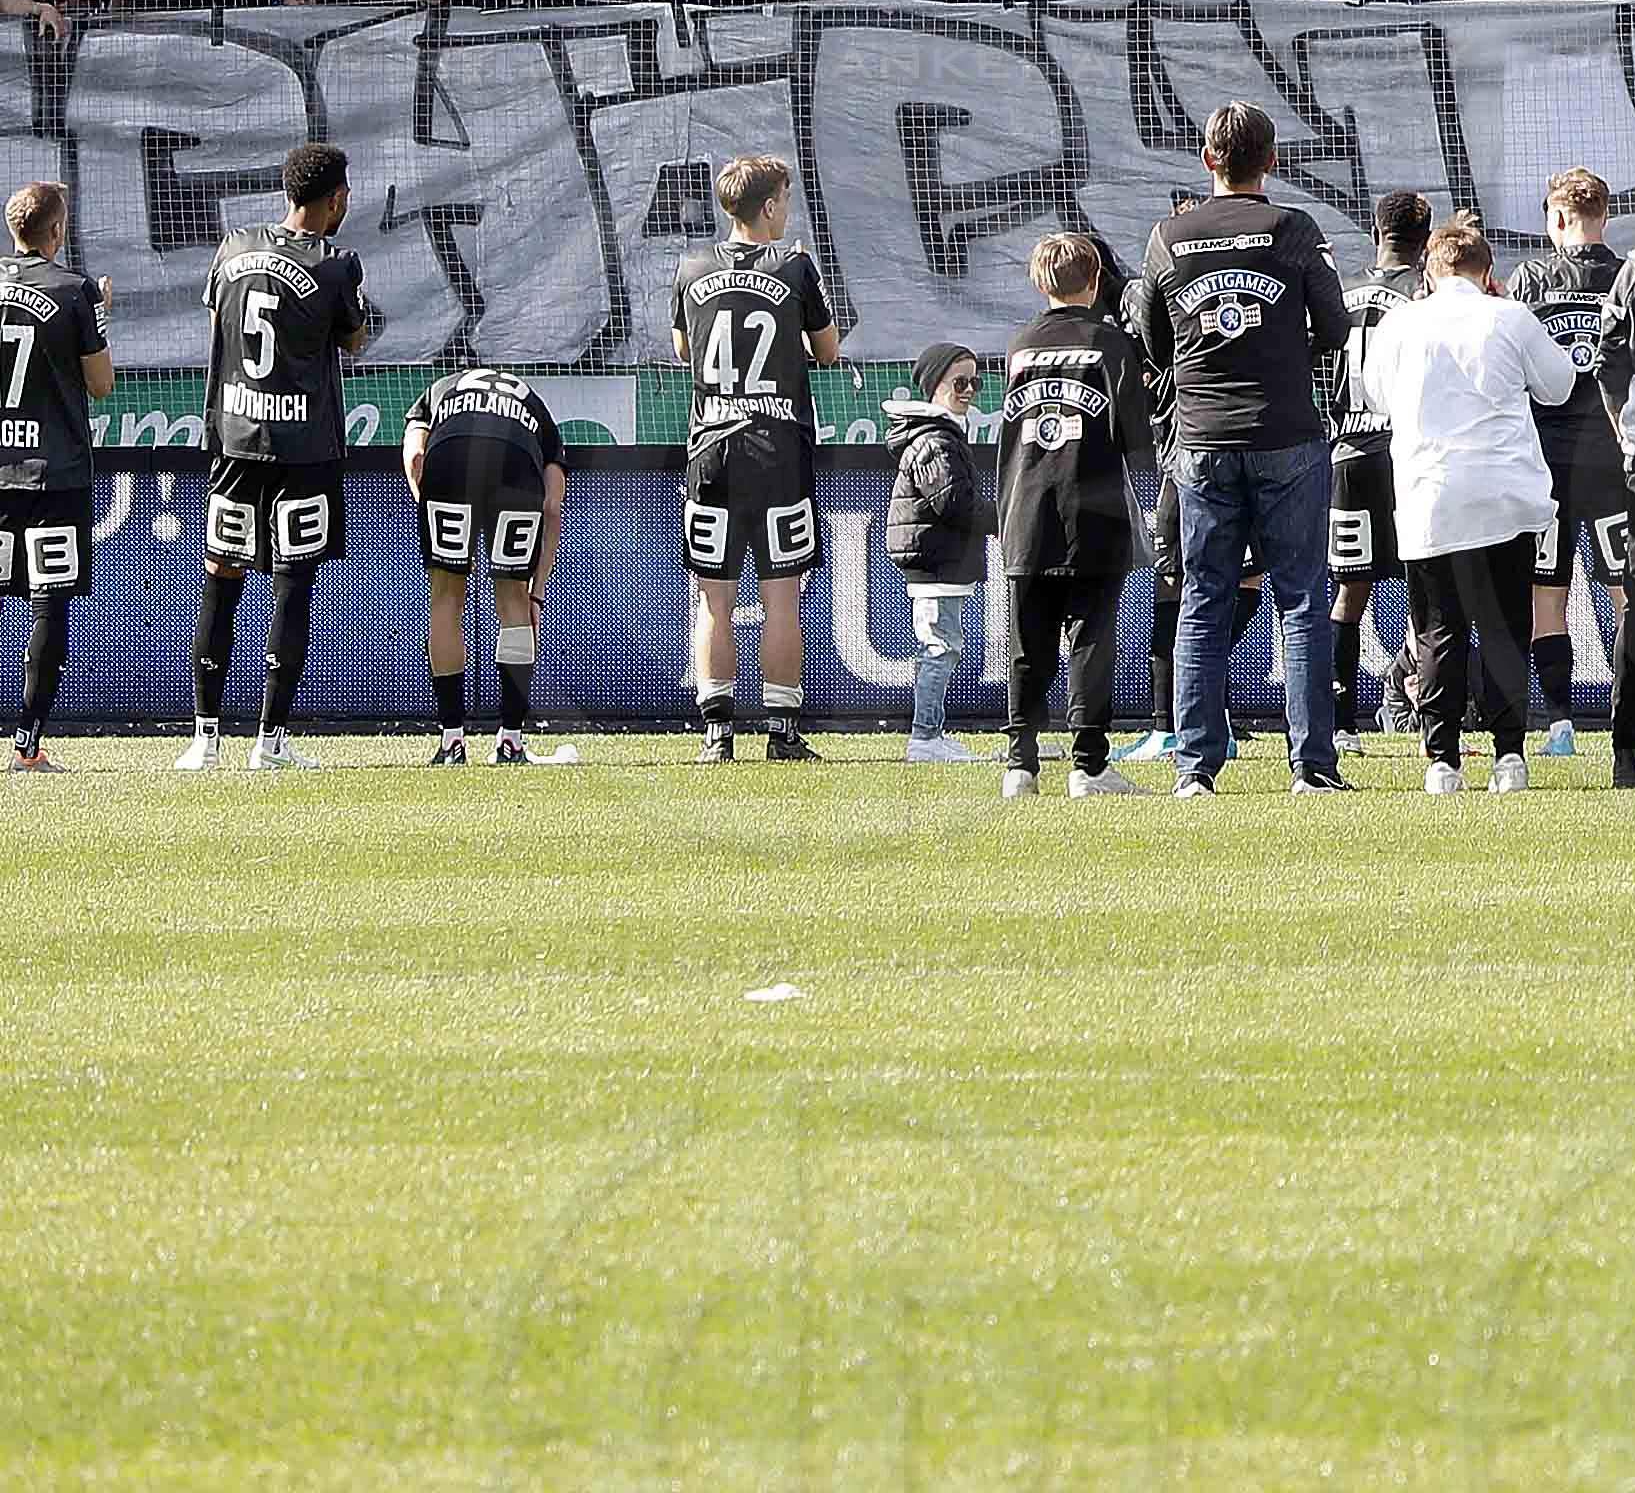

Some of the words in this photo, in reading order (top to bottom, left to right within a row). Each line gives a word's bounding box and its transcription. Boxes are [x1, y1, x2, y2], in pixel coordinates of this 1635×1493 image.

[224, 252, 318, 298] PUNTIGAMER
[692, 273, 788, 302] PUNTIGAMER
[1177, 270, 1284, 309] PUNTIGAMER
[243, 289, 279, 380] 5
[702, 309, 782, 394] 42
[1005, 377, 1110, 418] PUNTIGAMER
